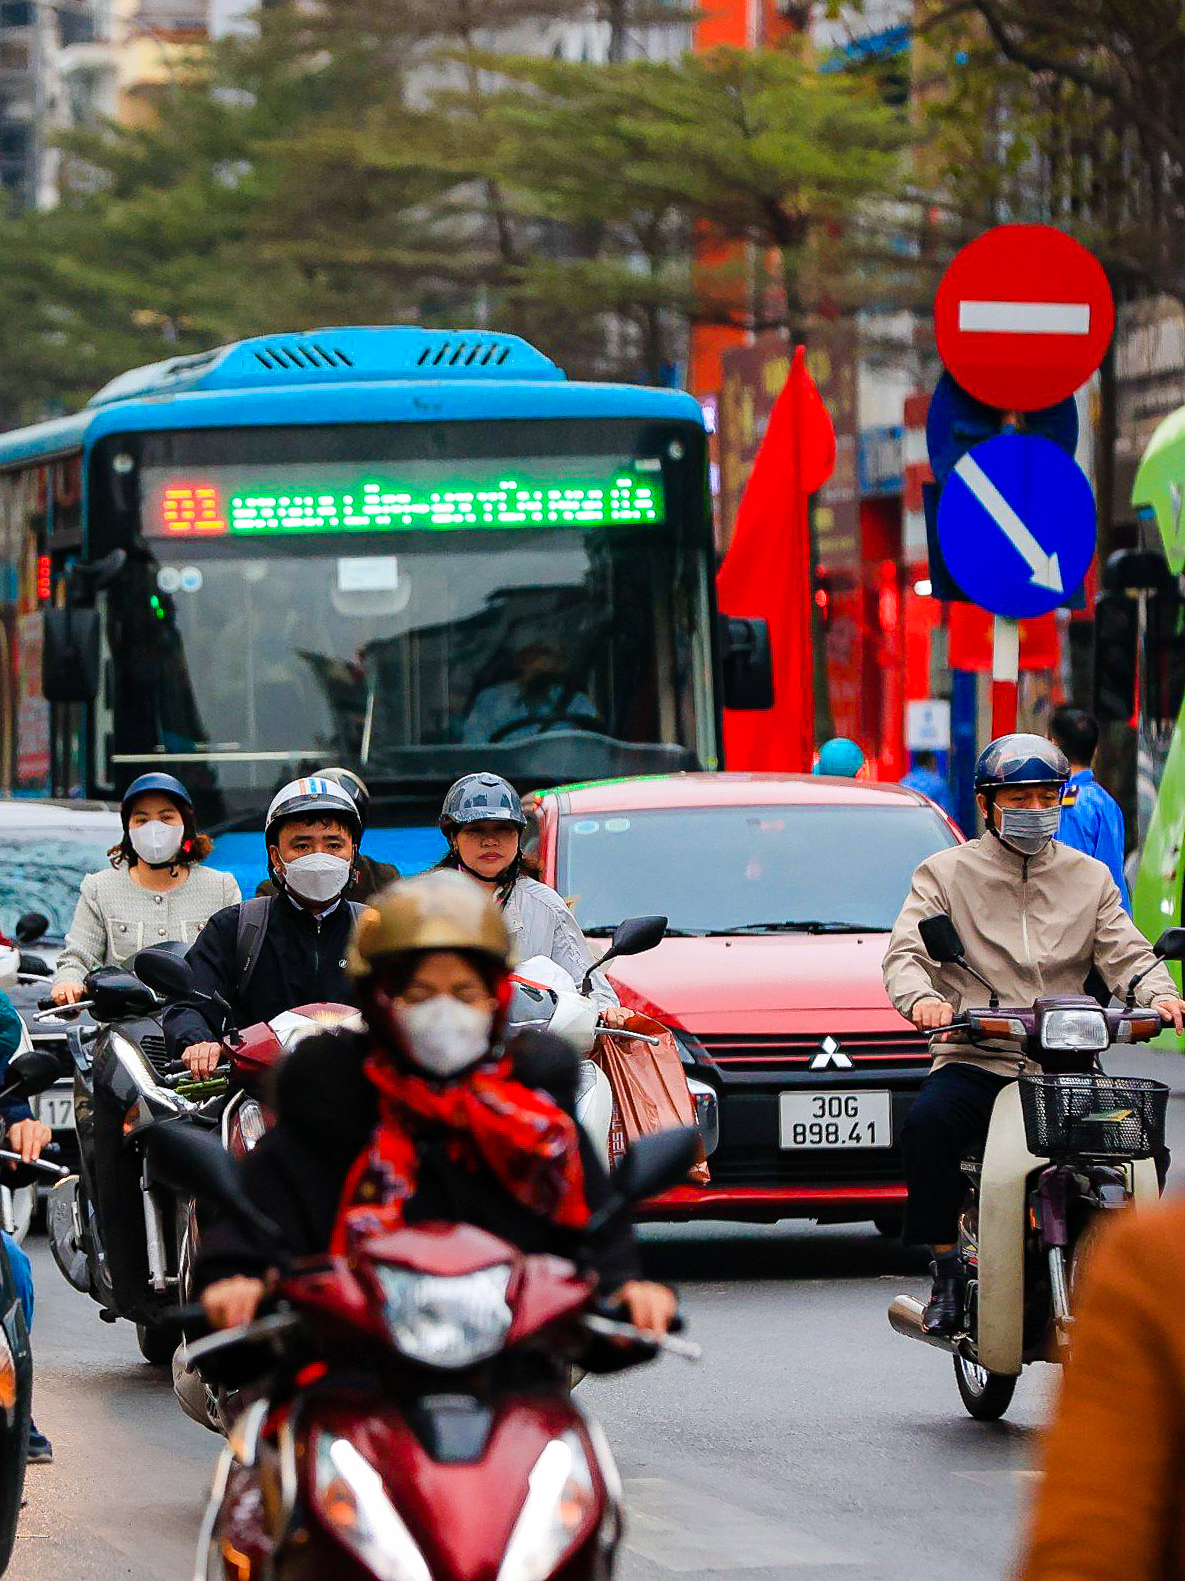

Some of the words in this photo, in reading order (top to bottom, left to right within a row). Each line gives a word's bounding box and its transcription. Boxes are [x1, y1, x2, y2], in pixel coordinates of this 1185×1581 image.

[163, 489, 225, 530] 01
[48, 1101, 72, 1125] 17
[812, 1096, 859, 1118] 30G
[792, 1121, 877, 1144] 898.41
